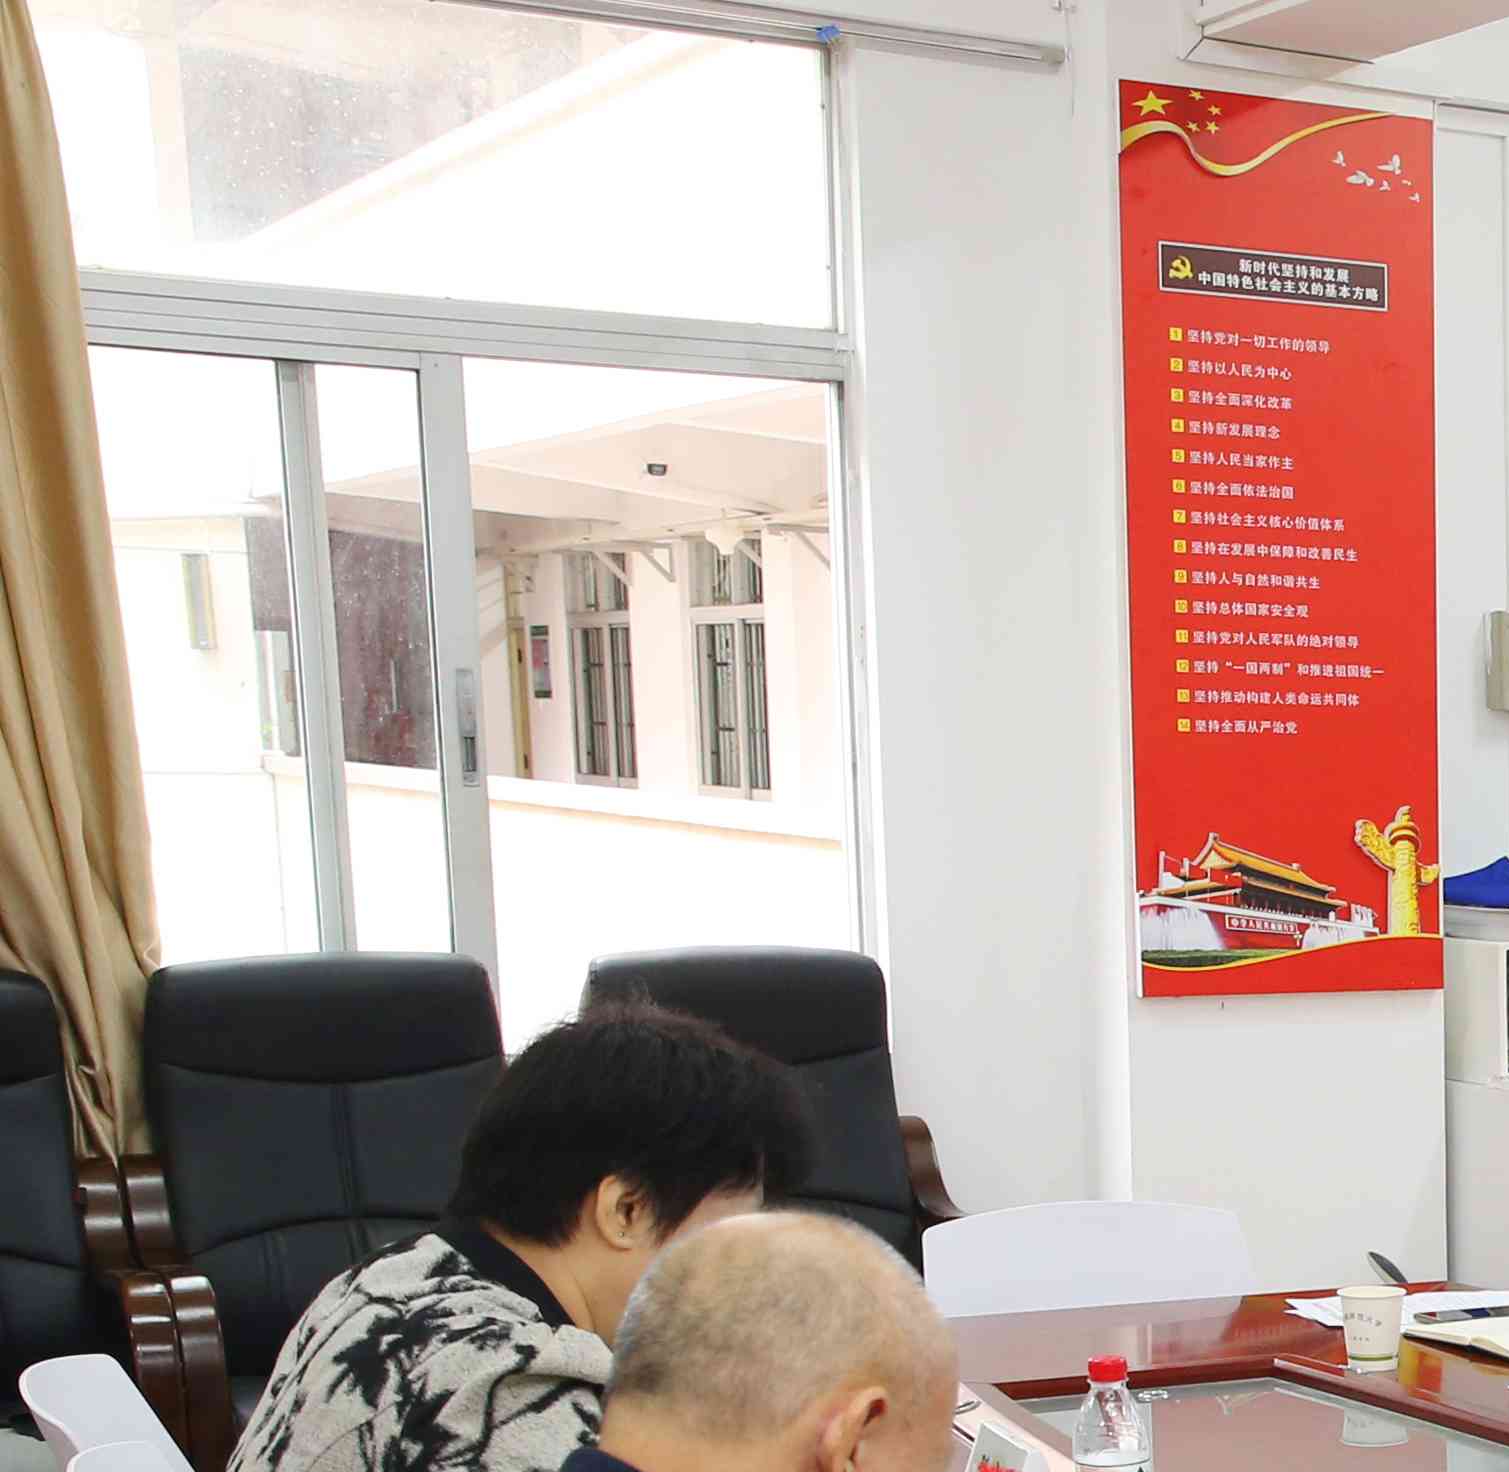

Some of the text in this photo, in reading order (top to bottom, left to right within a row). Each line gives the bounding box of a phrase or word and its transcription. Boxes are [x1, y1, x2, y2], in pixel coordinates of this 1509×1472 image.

[1238, 258, 1350, 285] 新时代坚持和发展
[1198, 271, 1379, 303] 中国特色社会主义的基本方略
[1187, 329, 1330, 354] 坚持党对一切工作的领导
[1187, 359, 1292, 381] 坚持以人民为中心
[1188, 390, 1293, 410] 坚持全面深化改革
[1188, 420, 1281, 440] 坚持新发展理念
[1189, 450, 1294, 471] 坚持人民当家作主
[1190, 481, 1294, 500] 坚持全面依法治国
[1190, 511, 1345, 532] 坚持社会主义核心价值体系
[1191, 540, 1358, 562] 坚持在发展中保障和改善民生
[1191, 570, 1321, 589] 坚持人与自然和谐共生
[1192, 600, 1309, 618] 坚持总体国家安全观
[1193, 630, 1359, 649] 坚持党对人民军队的绝对领导
[1194, 690, 1360, 707] 坚持推动构建人类命运共同体
[1195, 719, 1298, 734] 坚持全面从严治党
